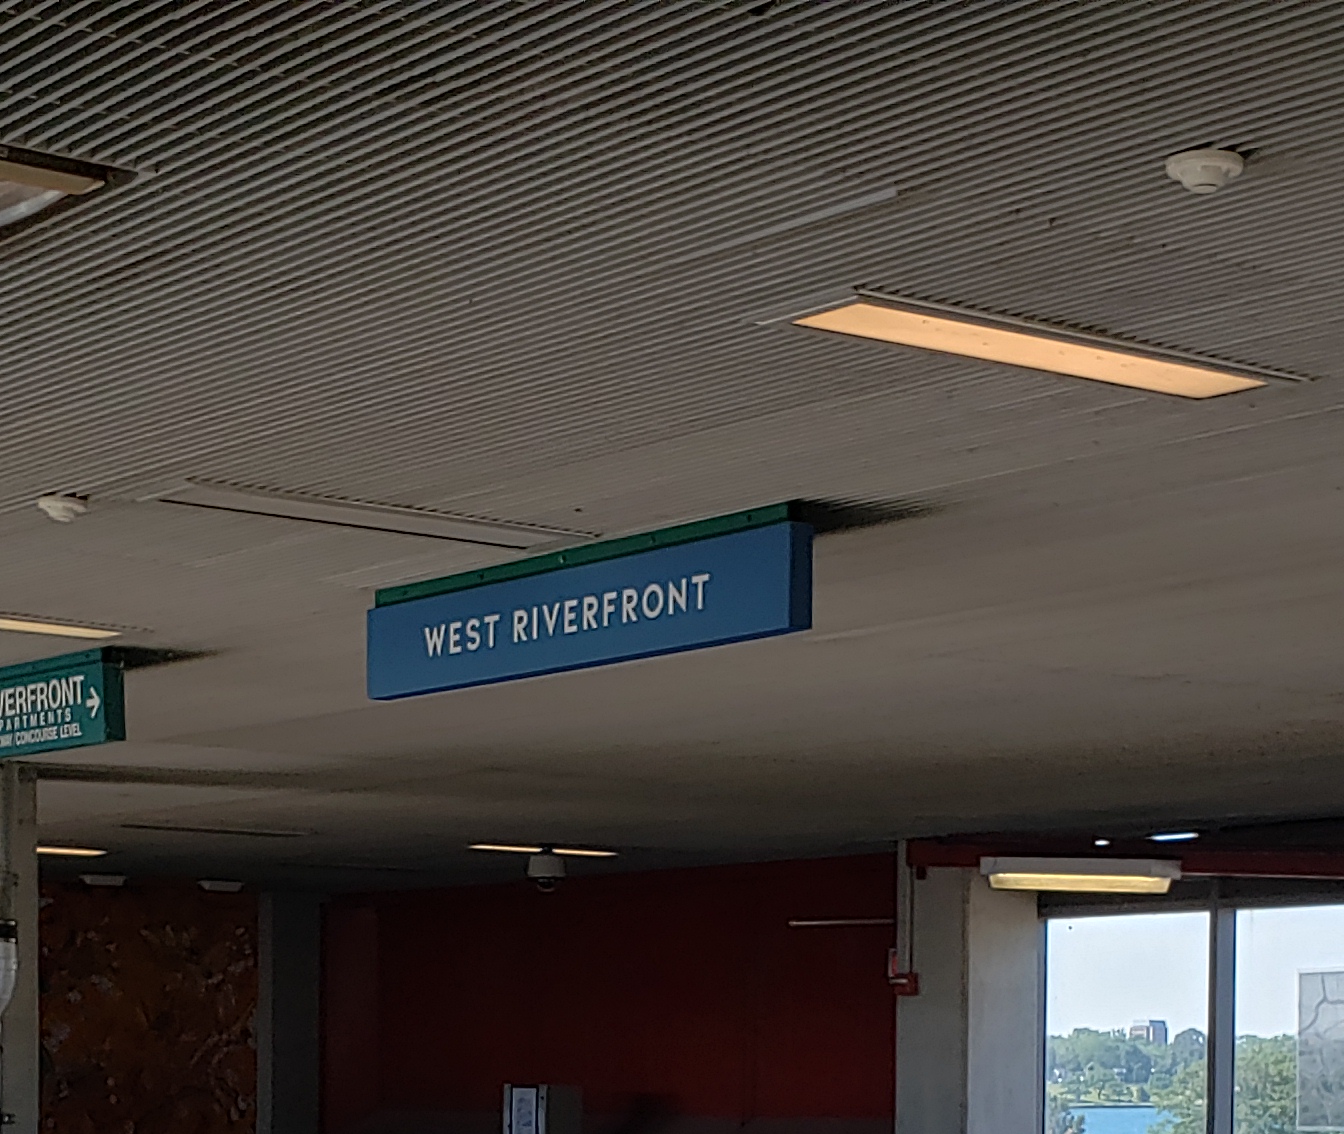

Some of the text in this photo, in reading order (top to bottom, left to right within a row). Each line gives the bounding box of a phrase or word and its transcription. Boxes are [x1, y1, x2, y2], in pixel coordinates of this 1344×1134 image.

[424, 573, 711, 658] WEST RIVERFRONT
[15, 726, 58, 746] CONCOURSE
[59, 722, 83, 739] LEVEL
